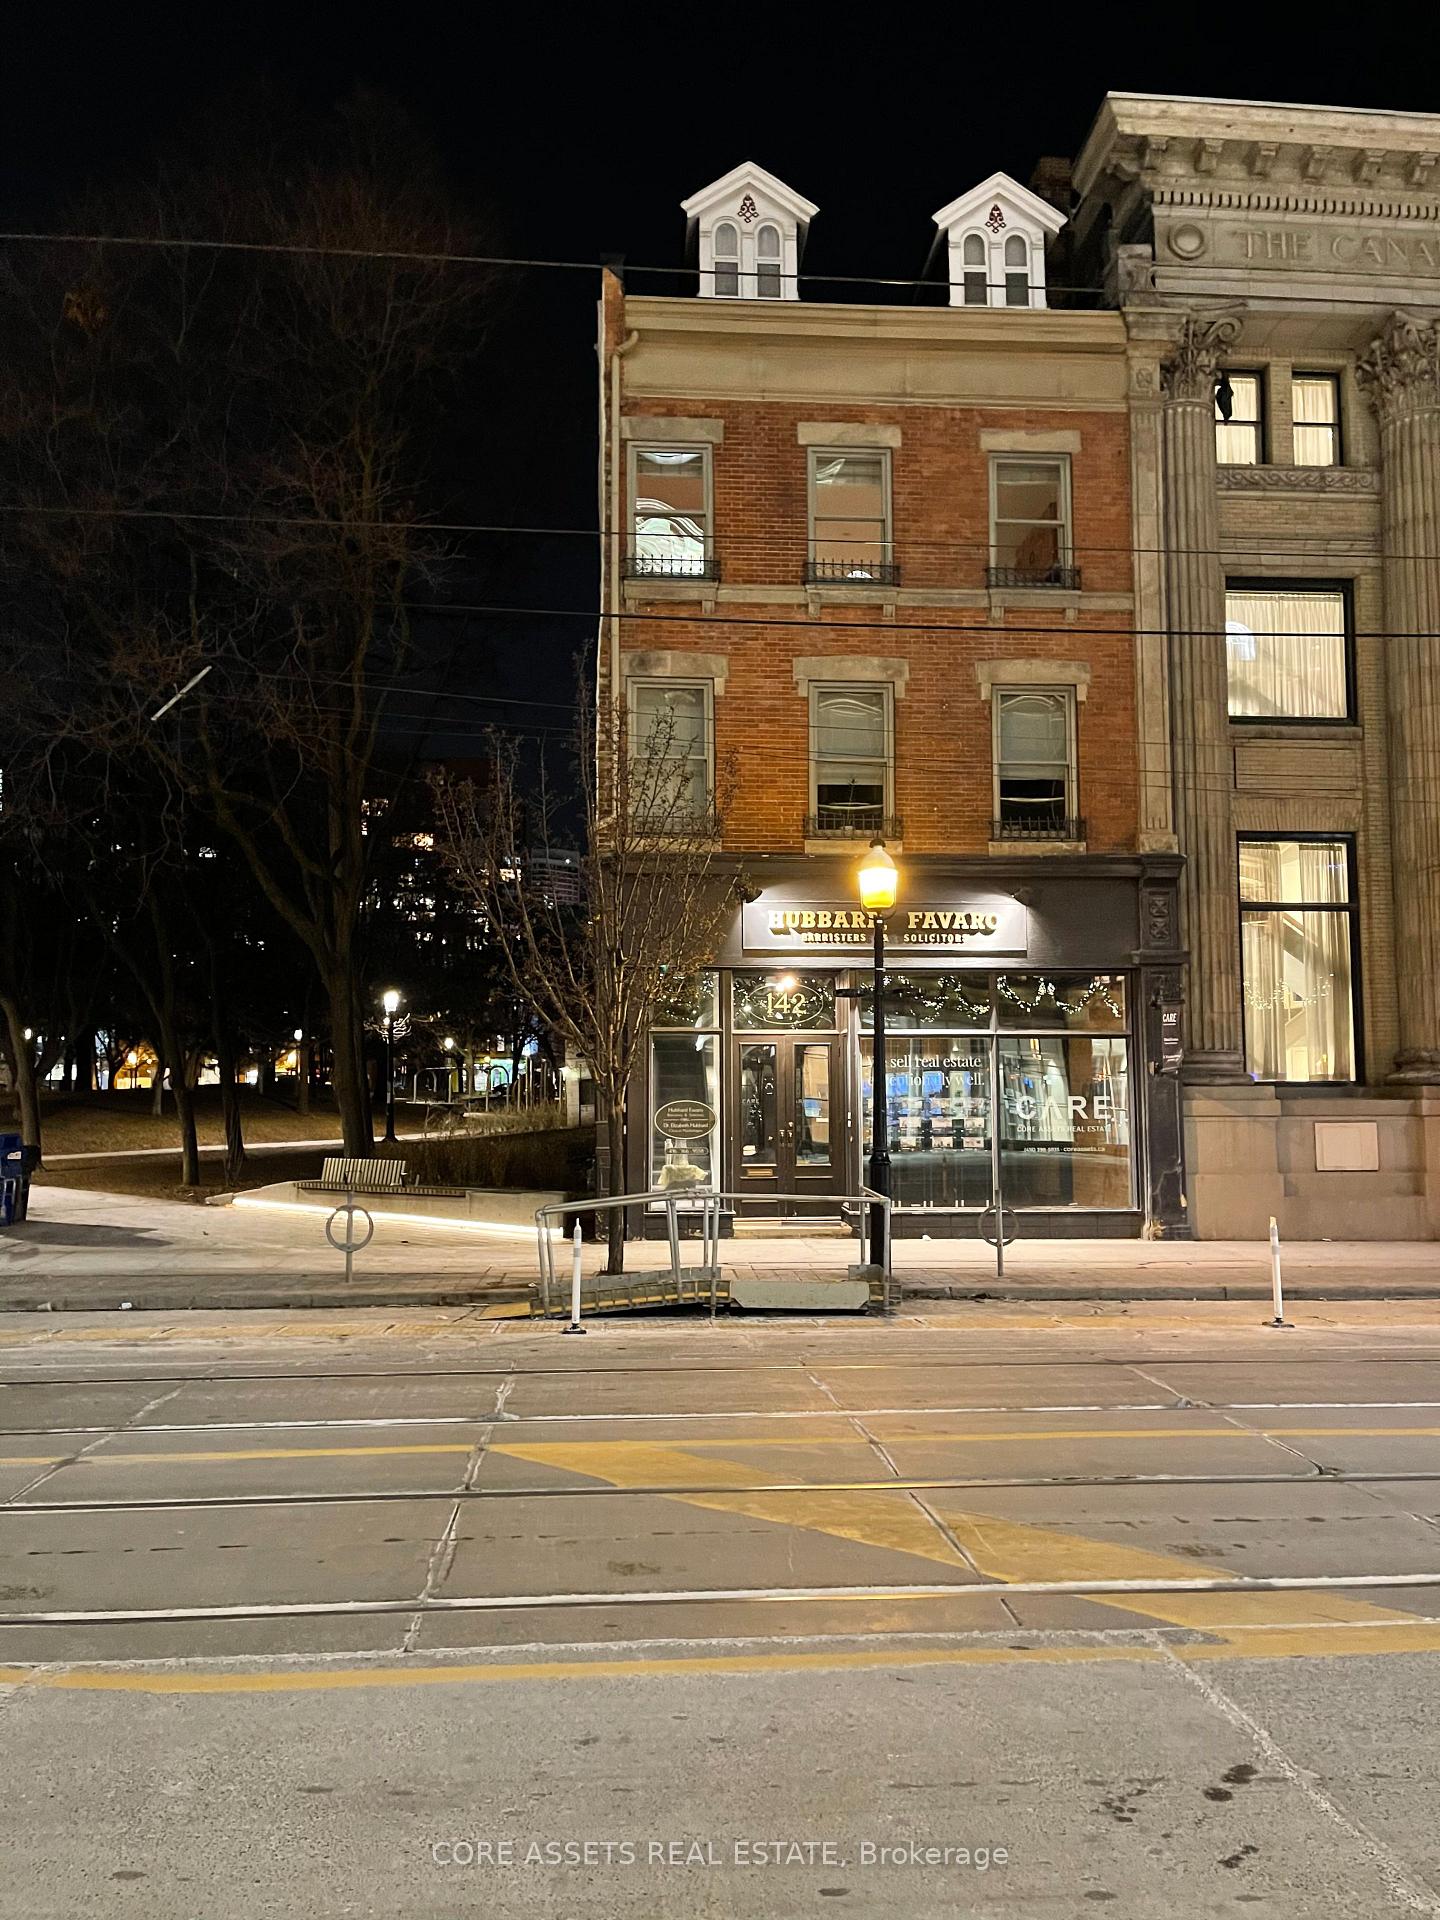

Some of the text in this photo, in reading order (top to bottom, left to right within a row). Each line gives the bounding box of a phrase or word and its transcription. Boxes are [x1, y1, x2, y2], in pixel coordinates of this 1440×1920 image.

[1232, 230, 1440, 268] THE CANA
[908, 911, 999, 930] FAVARO
[801, 933, 866, 943] BARRISTERS
[766, 991, 808, 1016] 142
[1163, 1013, 1177, 1023] CARE
[890, 1054, 911, 1068] sell
[915, 1054, 940, 1068] real
[943, 1056, 982, 1068] estate
[1017, 1095, 1112, 1120] CARE
